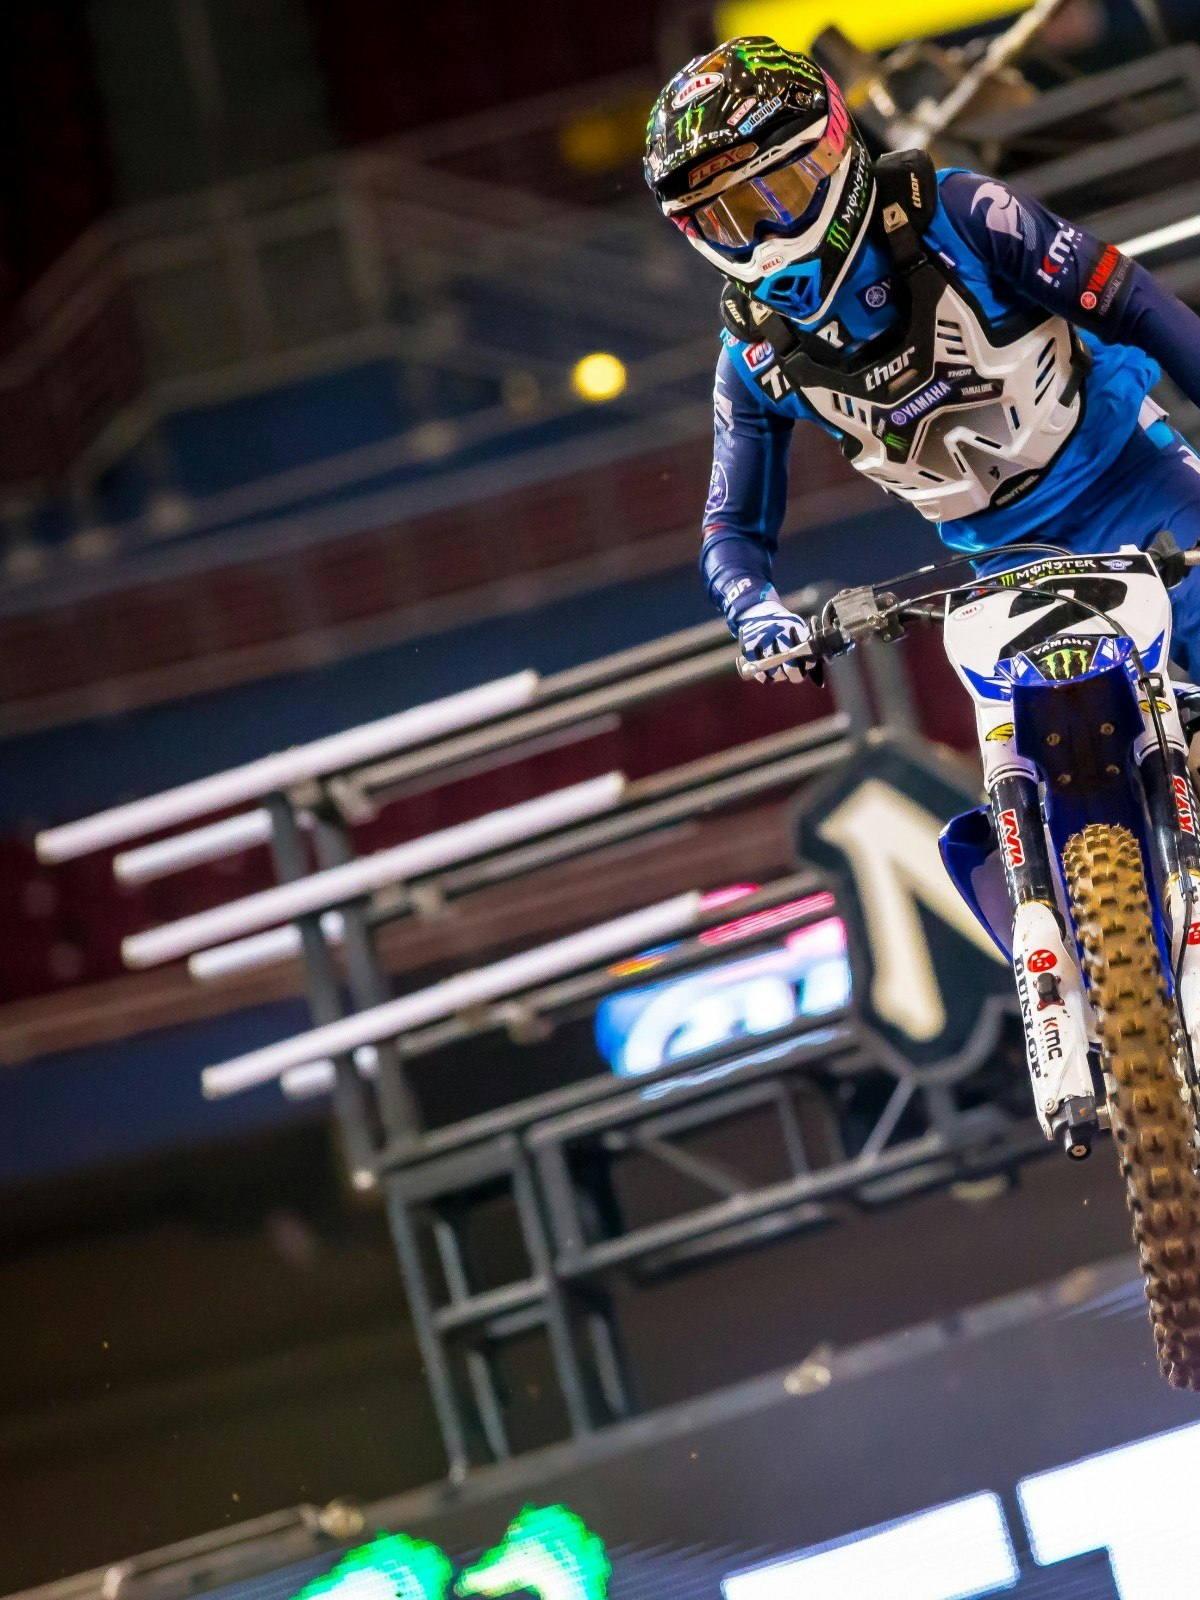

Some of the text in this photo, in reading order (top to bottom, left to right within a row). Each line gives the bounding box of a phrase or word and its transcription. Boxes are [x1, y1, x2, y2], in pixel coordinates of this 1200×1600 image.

[679, 77, 714, 101] BELL
[689, 149, 738, 184] FLEX
[911, 172, 922, 208] thor
[762, 257, 781, 271] BELL
[865, 346, 916, 391] thor
[947, 369, 972, 379] THOR
[902, 381, 951, 419] YAMAHA
[1016, 559, 1096, 580] MONSTER
[1033, 637, 1092, 655] YAMAHA
[1013, 954, 1042, 1080] DUNLOP
